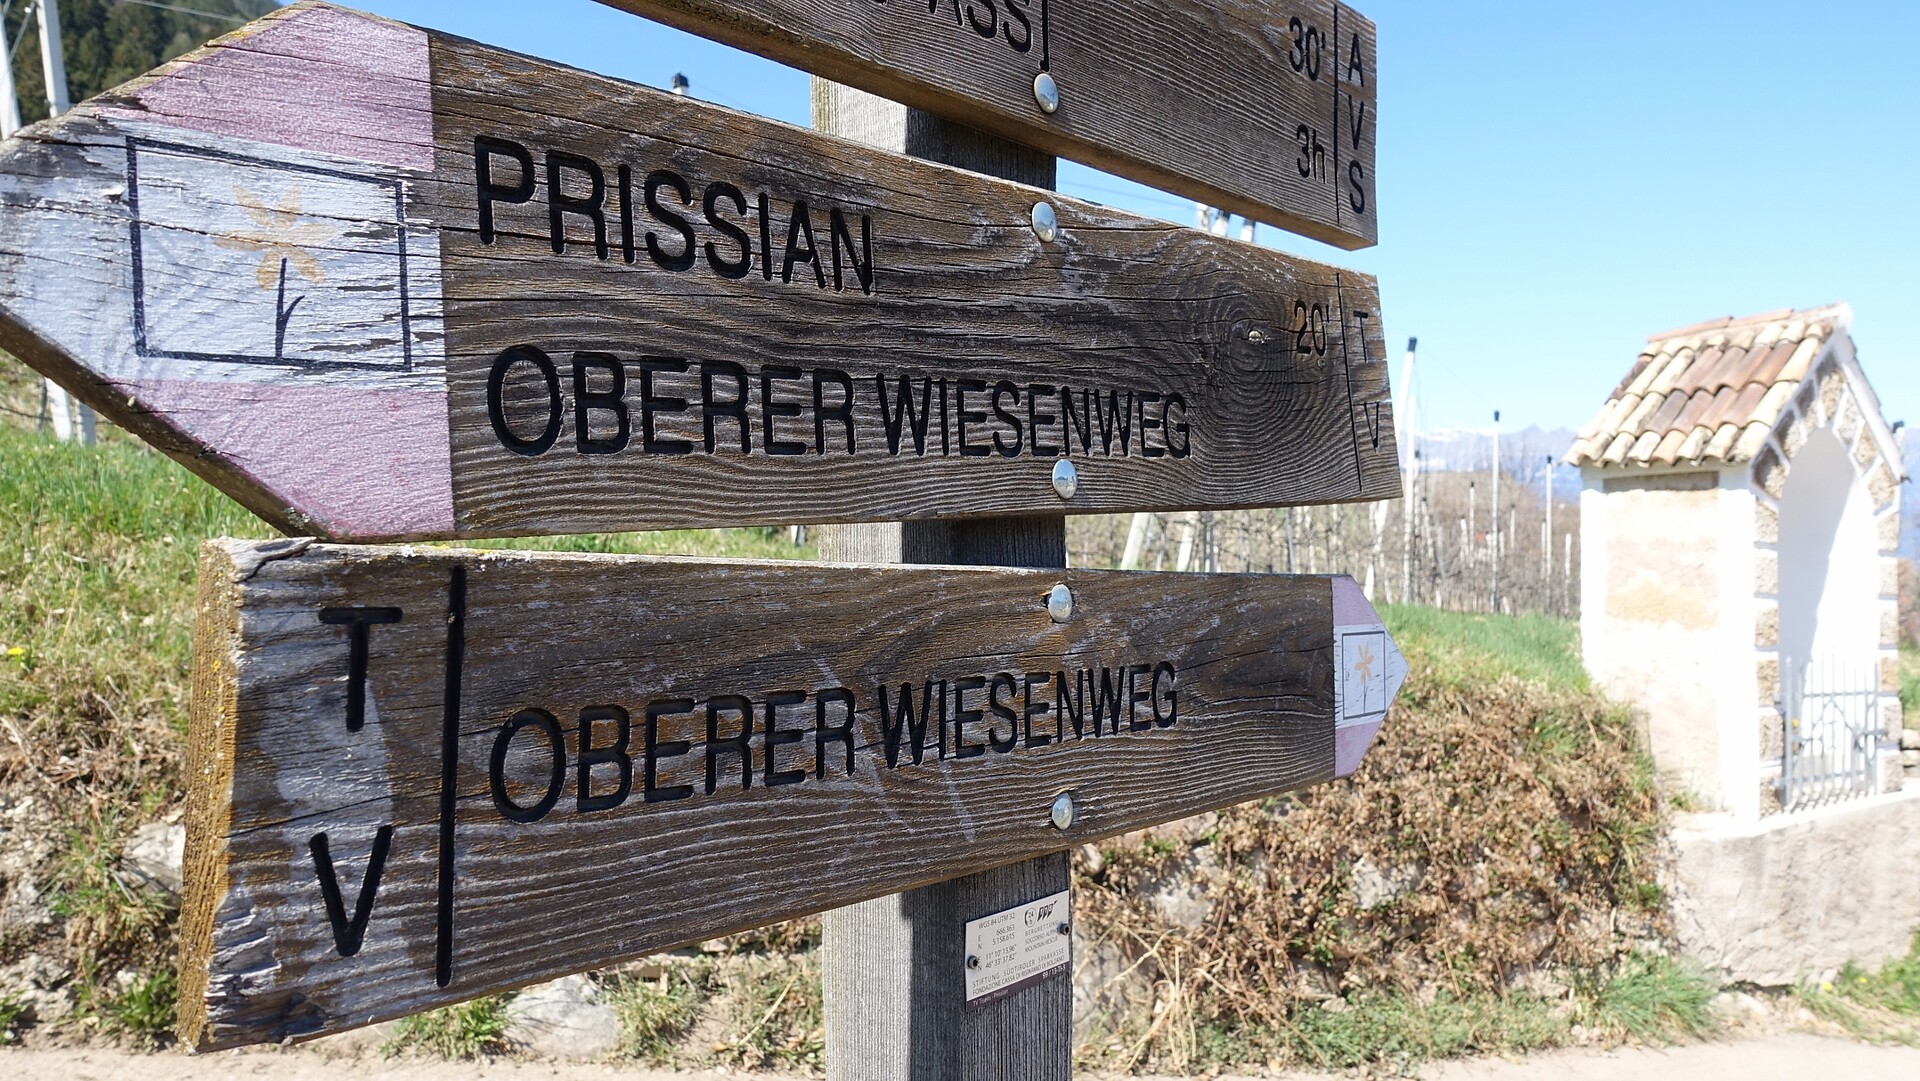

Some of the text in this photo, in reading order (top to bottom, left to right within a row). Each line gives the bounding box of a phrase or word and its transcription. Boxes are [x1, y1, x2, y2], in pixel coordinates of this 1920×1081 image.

[1289, 16, 1326, 81] 30'
[1297, 123, 1326, 184] 3h
[474, 135, 873, 296] PRISSIAN
[1294, 300, 1329, 356] 20'
[487, 344, 1192, 458] OBERER WIESENWEG
[489, 661, 1178, 824] OBERER WIESENWEG
[978, 912, 1016, 929] WGS 84 UTM 32
